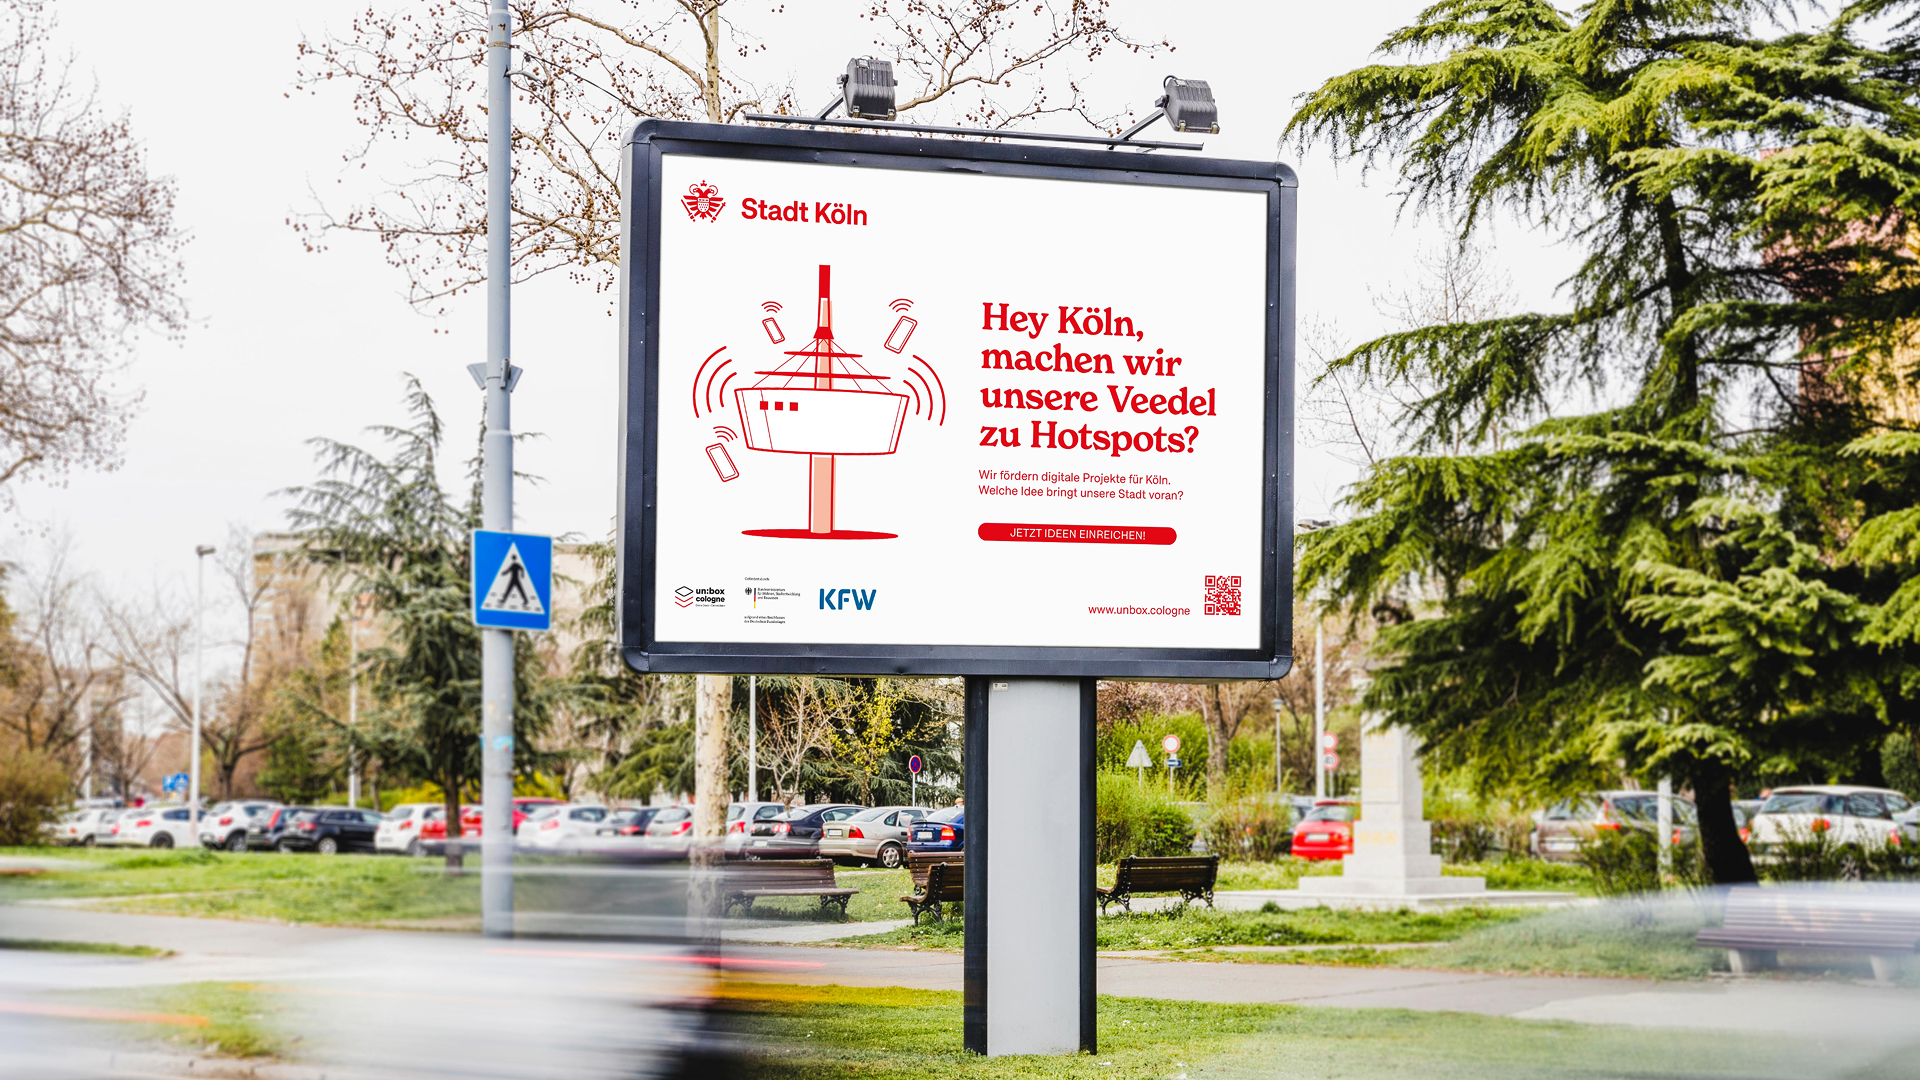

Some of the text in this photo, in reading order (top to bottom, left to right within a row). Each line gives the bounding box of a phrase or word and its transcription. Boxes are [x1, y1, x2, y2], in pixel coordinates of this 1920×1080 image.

[741, 197, 868, 226] Stadt Köln
[982, 302, 1144, 342] Hey Köln,
[981, 343, 1182, 377] machen wir
[980, 385, 1217, 417] unsere Veedel
[979, 420, 1200, 458] zu Hotspots?
[978, 469, 1171, 485] Wir fördern digitale Projekte für Köln.
[978, 485, 1184, 501] Welche Idee bringt unsere Stadt voran?
[1009, 527, 1146, 541] JETZT IDEEN EINREICHEN!
[695, 587, 725, 595] un:box
[695, 595, 726, 604] cologne
[819, 588, 877, 611] KFW
[1088, 604, 1191, 617] www.unbox.cologne
